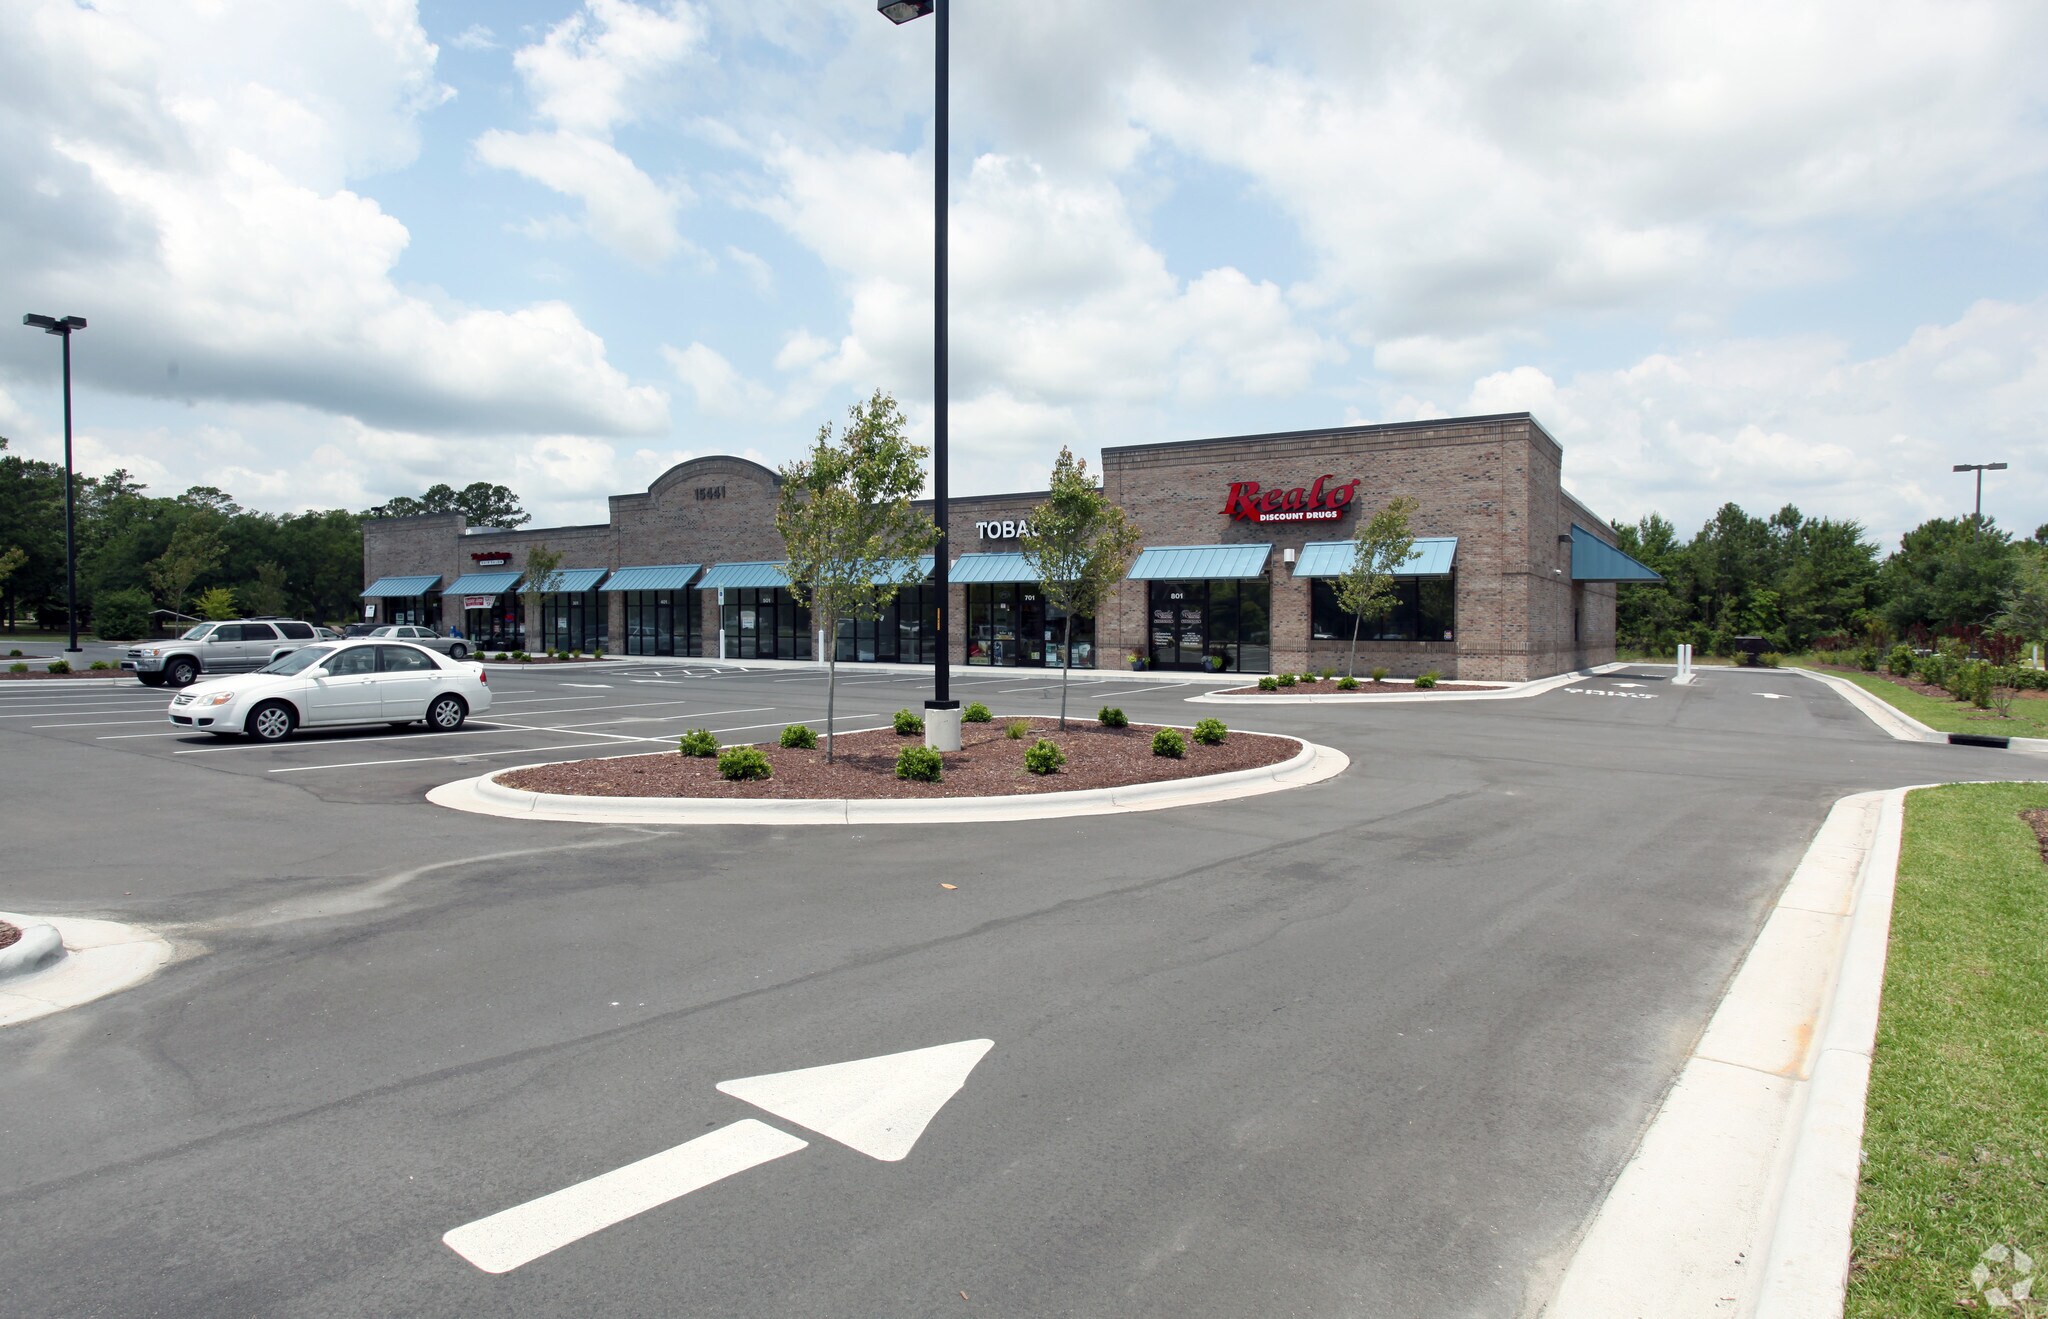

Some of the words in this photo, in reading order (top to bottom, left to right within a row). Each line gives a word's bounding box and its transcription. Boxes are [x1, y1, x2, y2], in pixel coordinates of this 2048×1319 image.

[695, 486, 725, 500] 15441
[1218, 474, 1360, 521] Realo
[1260, 512, 1303, 521] DISCOUNT
[1306, 511, 1338, 519] DRUGS
